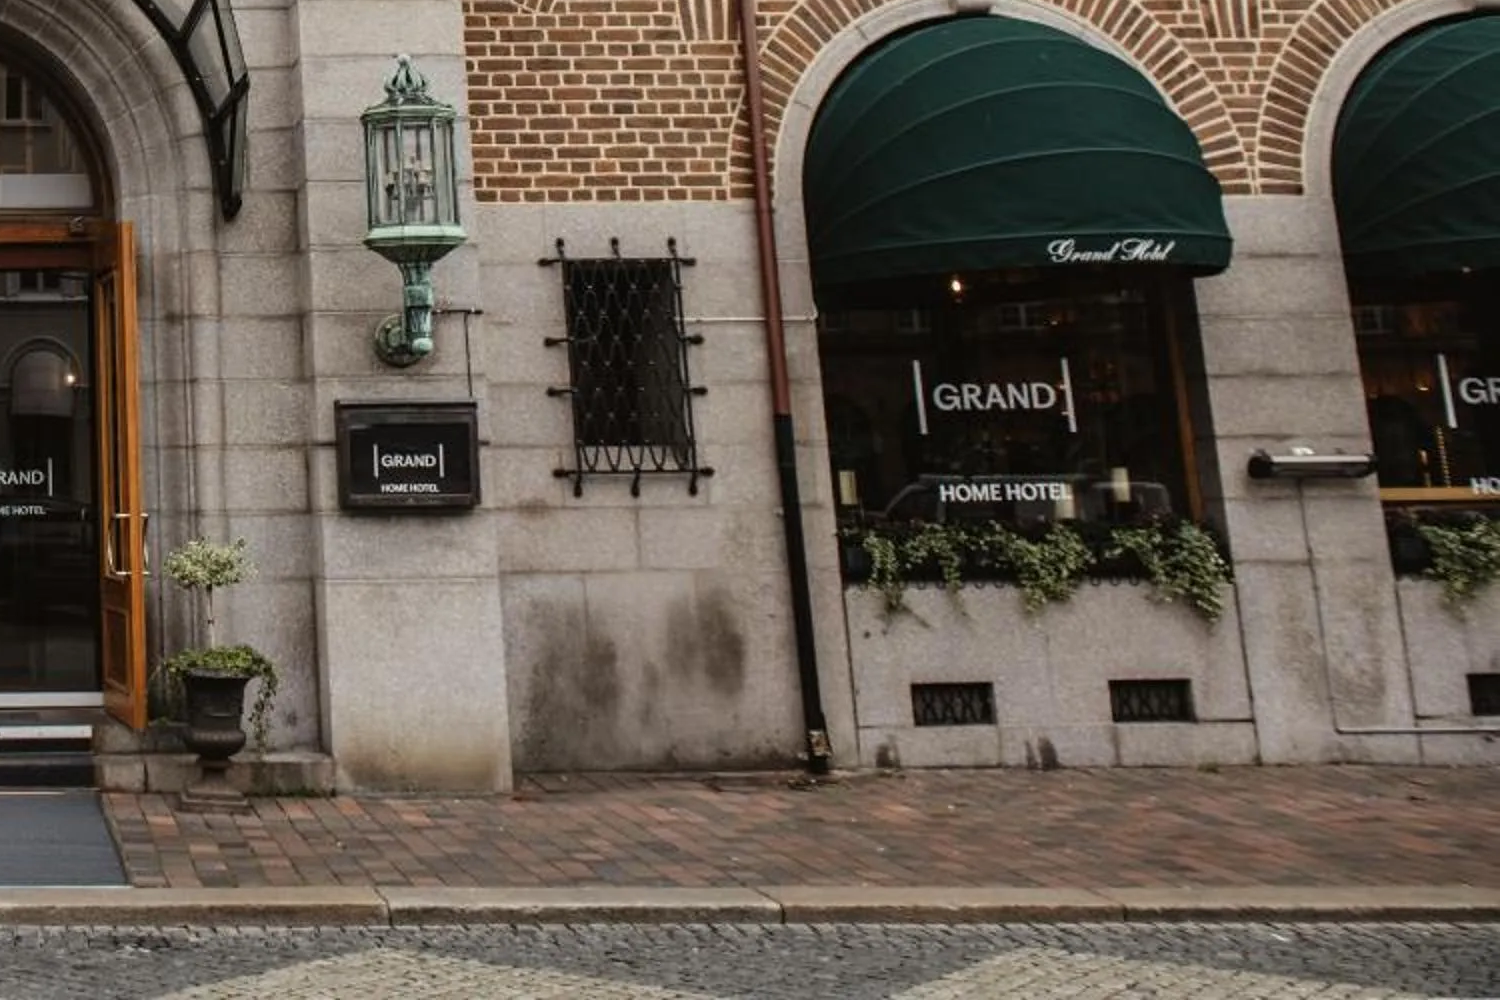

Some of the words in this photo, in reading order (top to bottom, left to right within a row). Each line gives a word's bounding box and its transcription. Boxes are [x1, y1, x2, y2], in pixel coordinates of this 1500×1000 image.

[1047, 238, 1120, 262] Grand
[1120, 238, 1176, 261] Hotel
[933, 383, 1056, 410] GRAND
[381, 454, 437, 467] GRAND
[381, 484, 409, 493] HOME
[410, 484, 440, 493] HOTEL
[940, 484, 1002, 502] HOME
[1005, 483, 1073, 501] HOTEL
[12, 505, 46, 516] HOTEL
